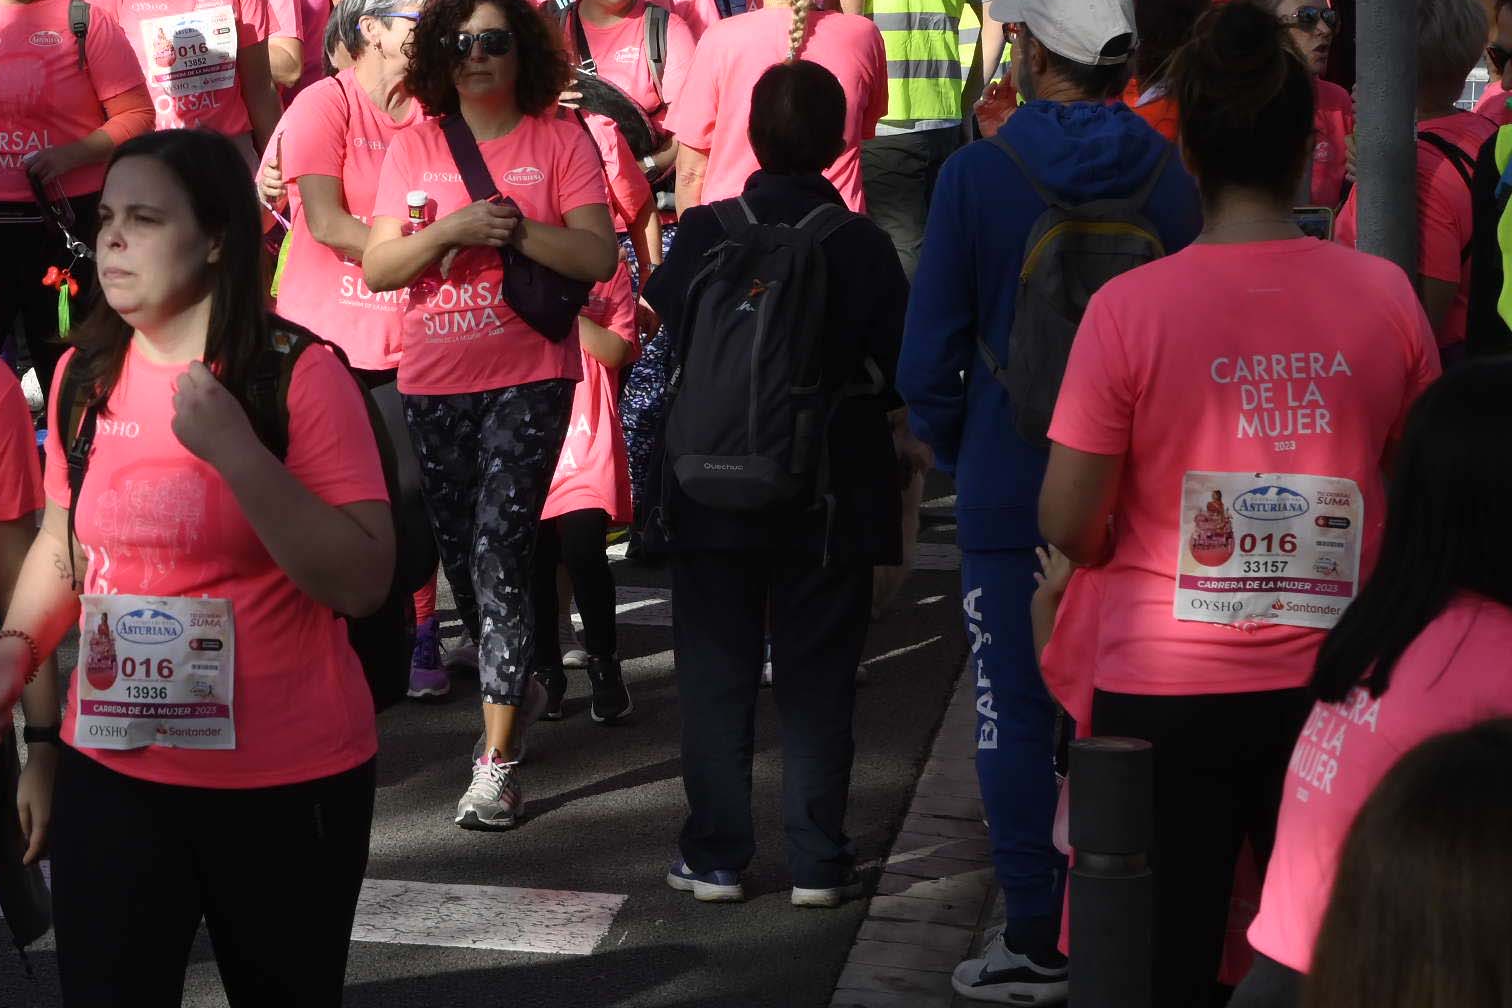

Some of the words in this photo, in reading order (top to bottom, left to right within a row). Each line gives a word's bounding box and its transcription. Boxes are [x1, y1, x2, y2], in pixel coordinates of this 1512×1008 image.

[178, 42, 208, 58] 016
[423, 307, 501, 335] SUMA
[1210, 349, 1353, 384] CARRERA
[1241, 383, 1274, 410] DE
[1287, 381, 1325, 407] LA
[1236, 409, 1334, 439] MUJER
[1274, 440, 1297, 451] 2023
[1239, 499, 1304, 514] ASTURIANA
[1316, 496, 1352, 507] SUMA
[1238, 532, 1298, 554] 016
[1242, 560, 1289, 574] 33157
[1197, 580, 1246, 589] CARRERA
[1246, 581, 1261, 589] DE
[1262, 581, 1275, 589] LA
[1276, 581, 1312, 590] MUJER
[1191, 597, 1244, 613] OYSHO
[1285, 600, 1342, 616] Santander
[120, 621, 178, 637] ASTURIANA
[190, 618, 223, 628] SUMA
[121, 656, 175, 680] 016
[126, 686, 168, 700] 13936
[93, 704, 127, 715] CARRERA
[128, 706, 141, 715] DE
[143, 706, 156, 715] LA
[157, 706, 192, 716] MUJER
[89, 724, 128, 738] OYSHO
[168, 726, 223, 738] Santander
[1322, 717, 1347, 757] LA
